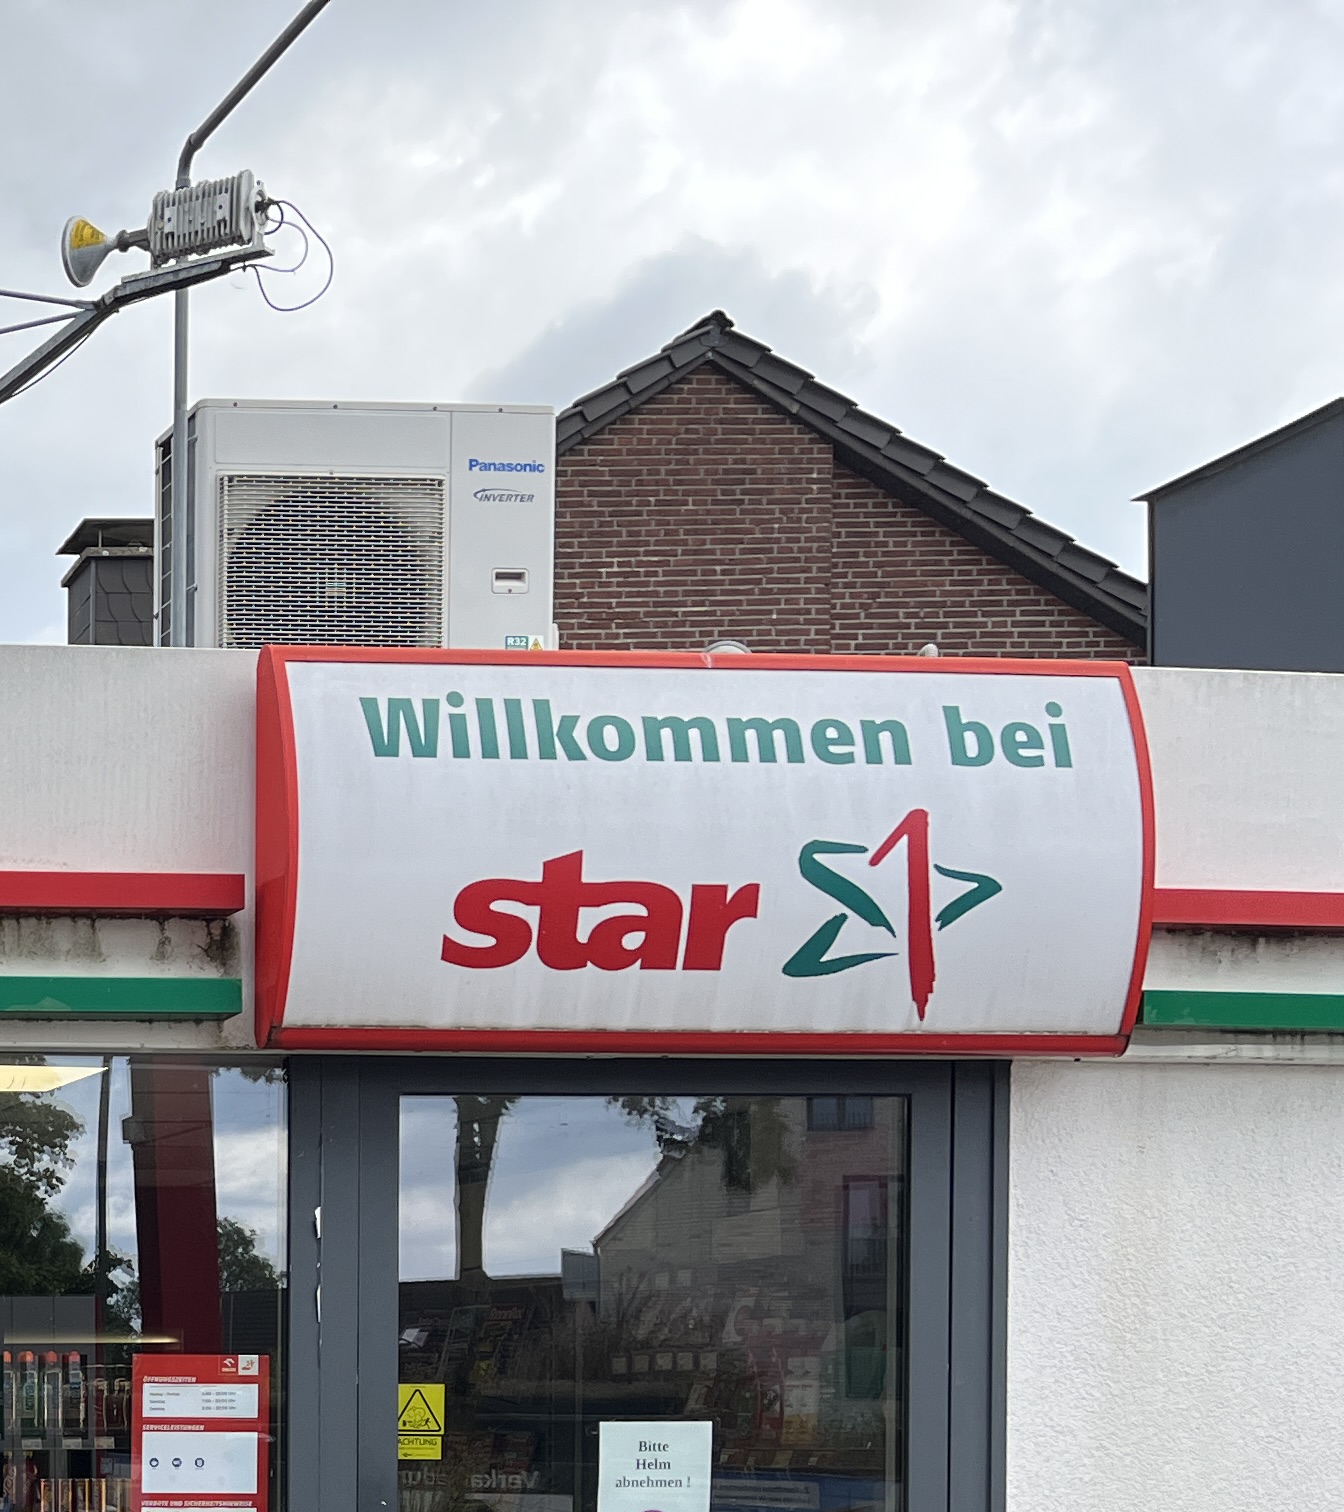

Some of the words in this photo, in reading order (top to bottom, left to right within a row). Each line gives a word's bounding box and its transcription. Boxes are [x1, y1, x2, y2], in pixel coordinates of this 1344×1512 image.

[468, 458, 545, 473] Panasonic
[478, 493, 535, 503] INVERTER
[507, 637, 527, 647] R32
[359, 691, 914, 767] Willkommen
[942, 701, 1074, 770] bei
[441, 850, 760, 972] star
[398, 1438, 438, 1447] ACHTUNG
[638, 1440, 670, 1452] Bitte
[635, 1458, 671, 1470] Helm
[615, 1476, 683, 1488] abnehmen
